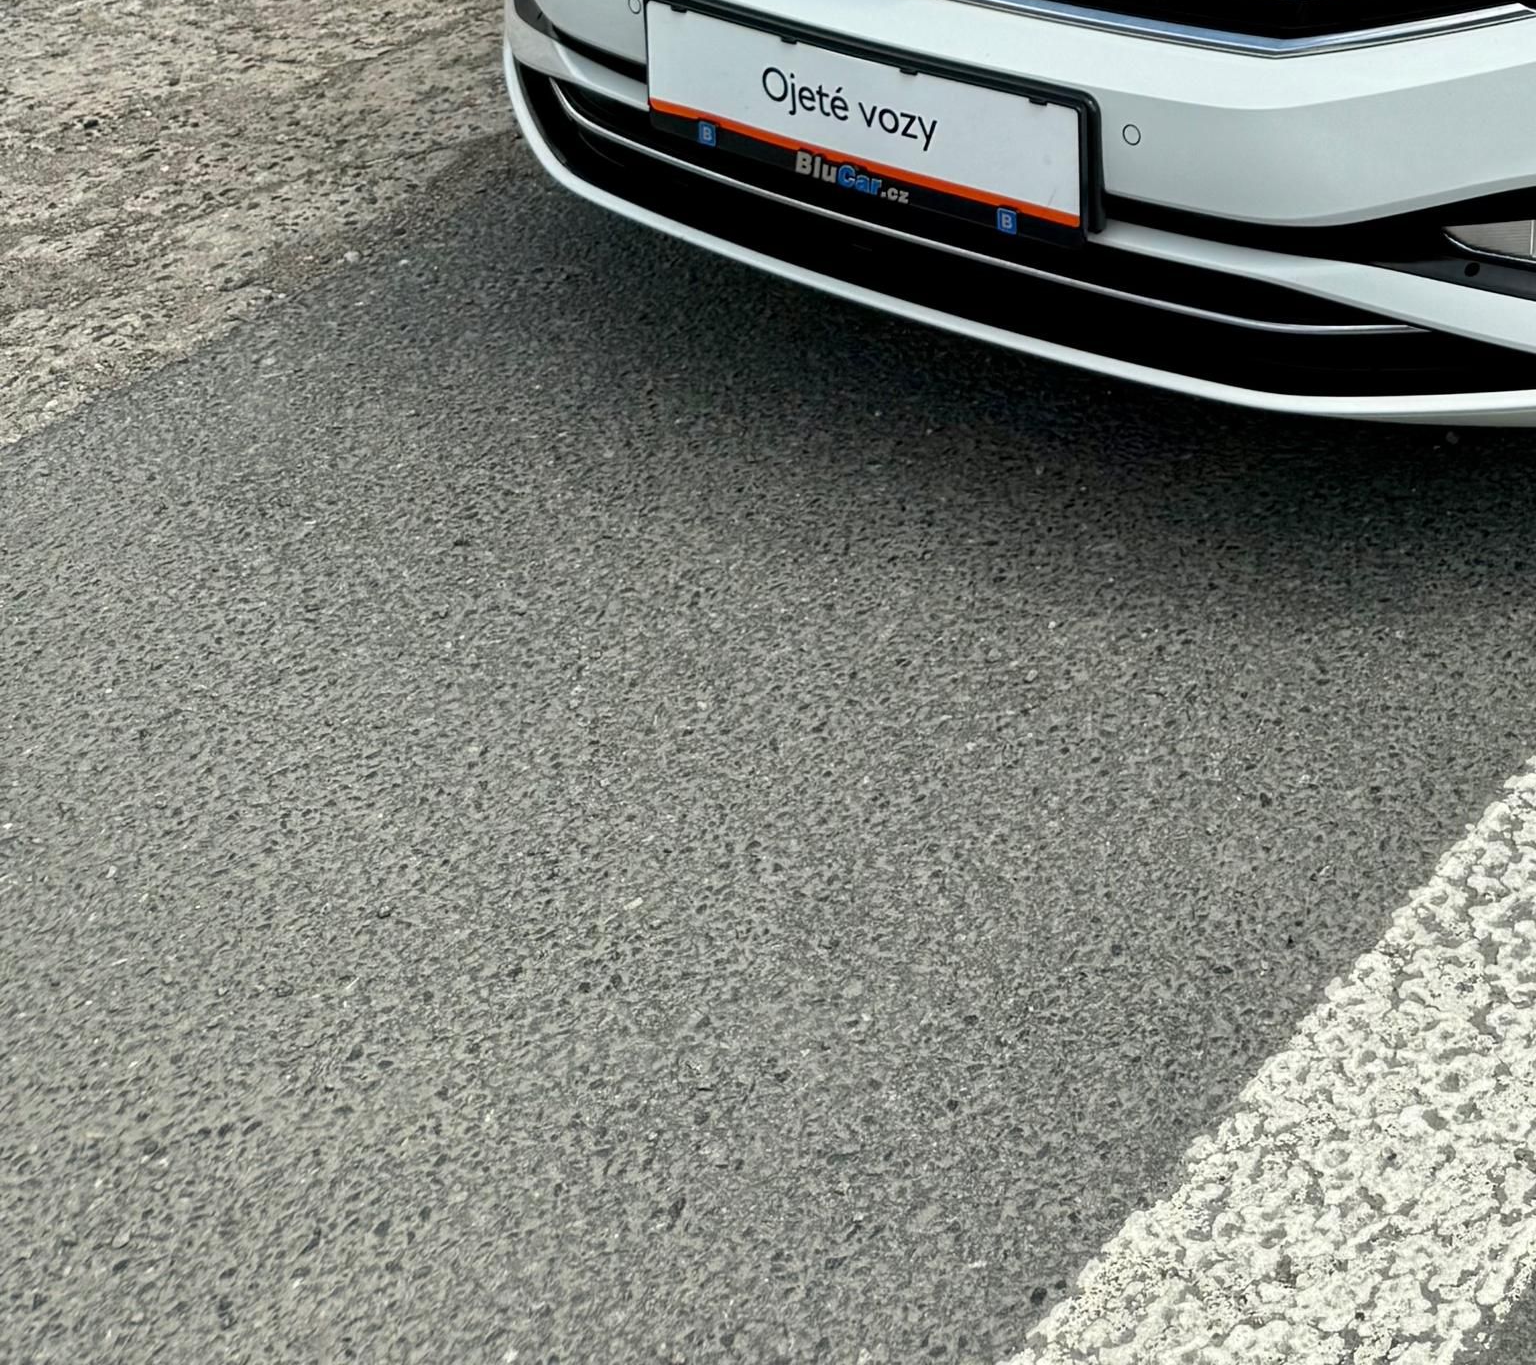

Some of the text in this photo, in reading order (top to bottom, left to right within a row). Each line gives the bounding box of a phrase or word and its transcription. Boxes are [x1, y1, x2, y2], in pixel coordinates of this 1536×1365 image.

[762, 67, 938, 152] Ojeté vozy
[795, 151, 909, 205] BluCar.cz
